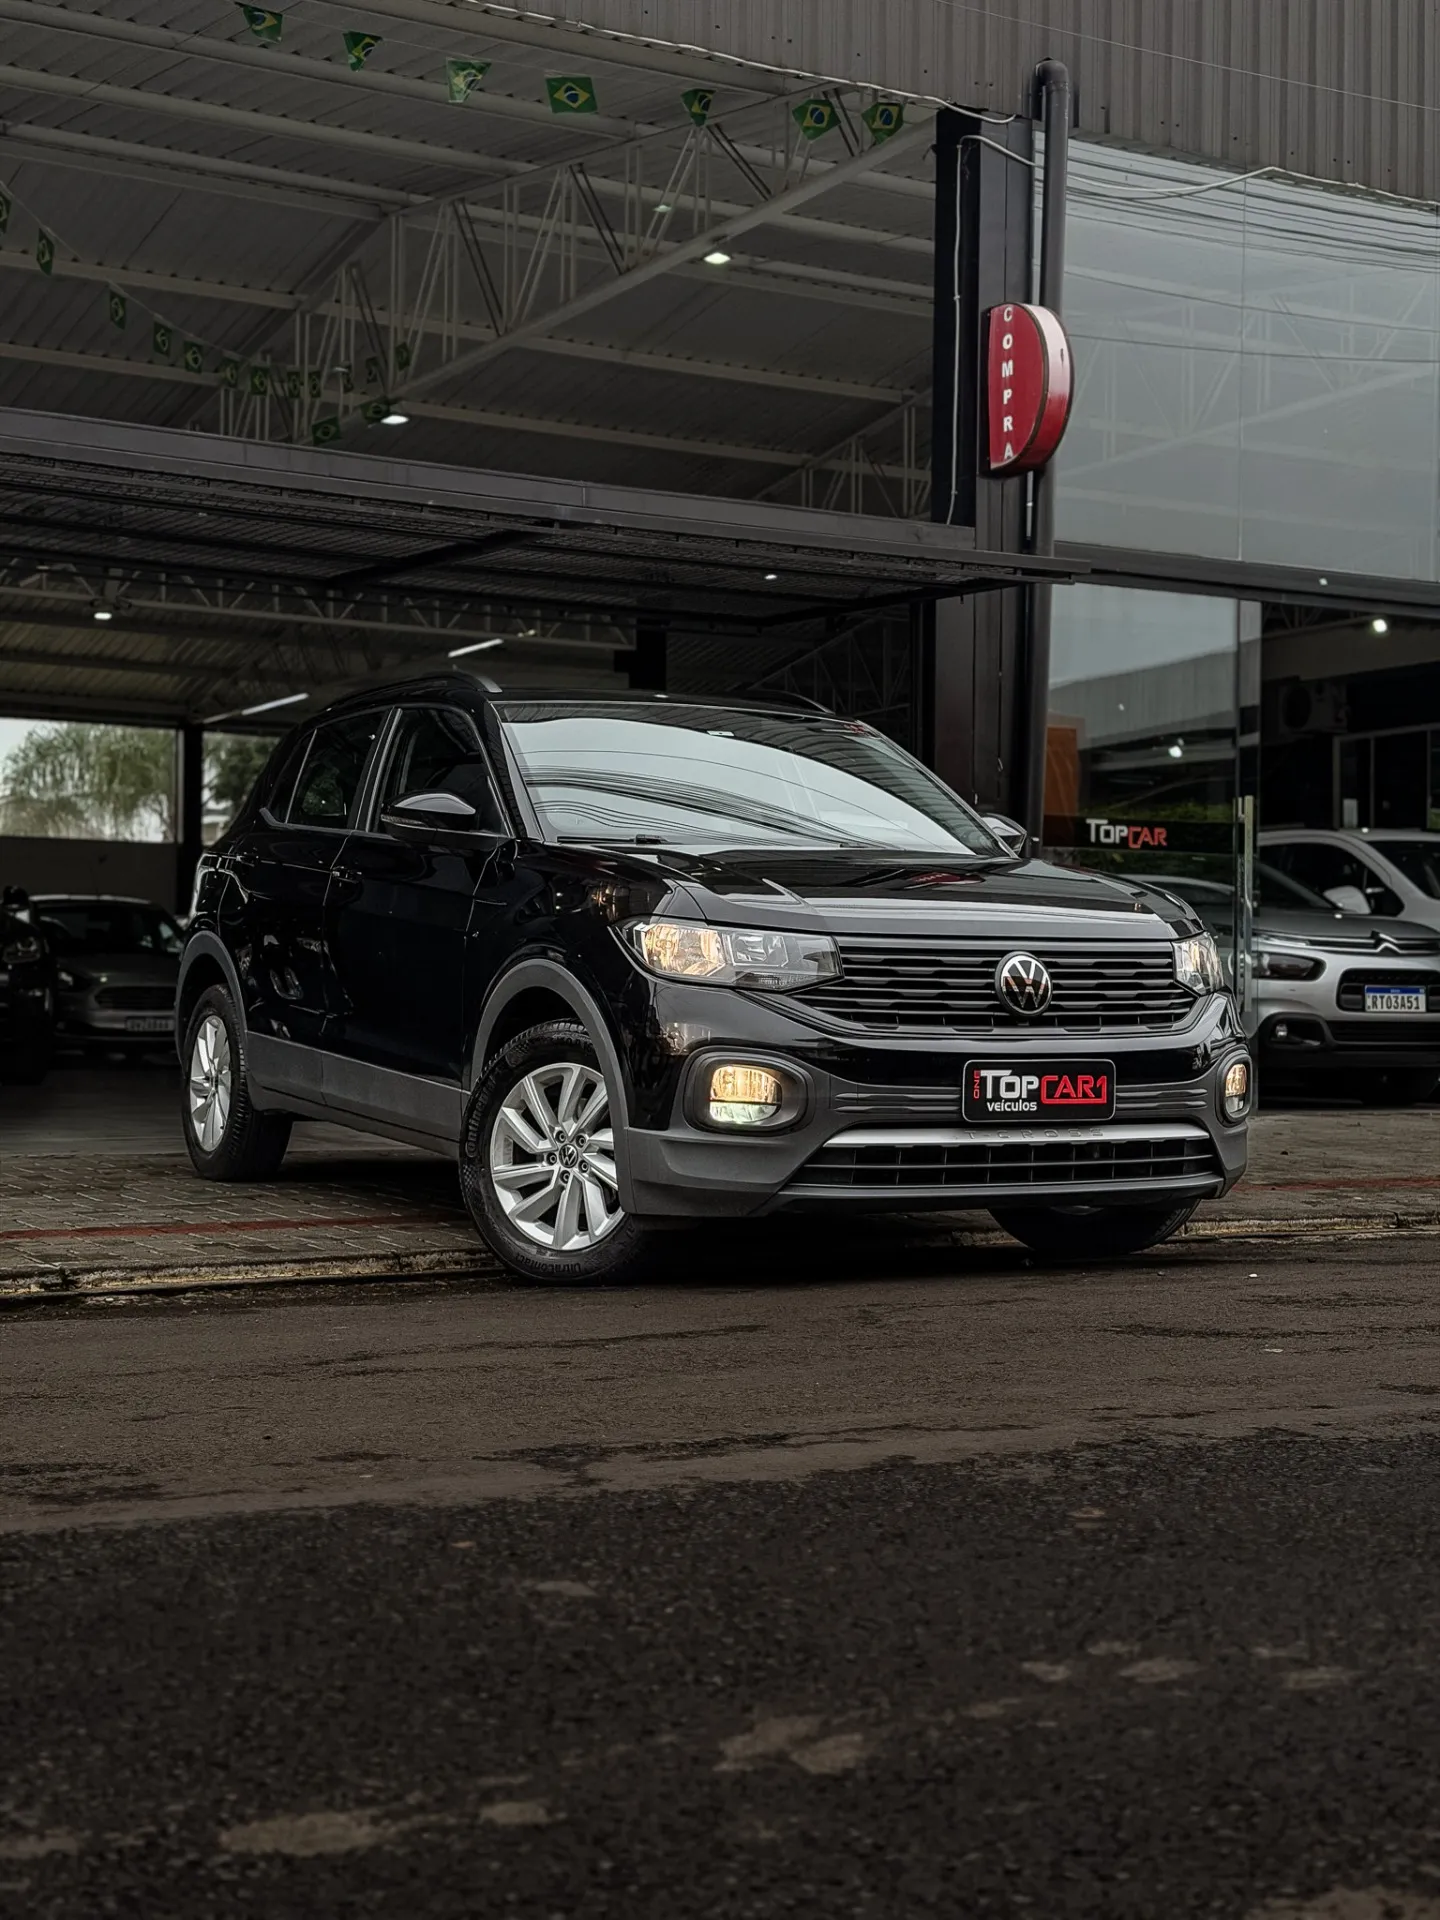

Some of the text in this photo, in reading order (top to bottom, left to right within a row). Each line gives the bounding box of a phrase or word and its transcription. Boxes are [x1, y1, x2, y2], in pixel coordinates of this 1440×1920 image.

[1002, 306, 1014, 460] COMPRA
[986, 1099, 1037, 1112] veículos
[964, 1127, 1104, 1140] T-CROSS
